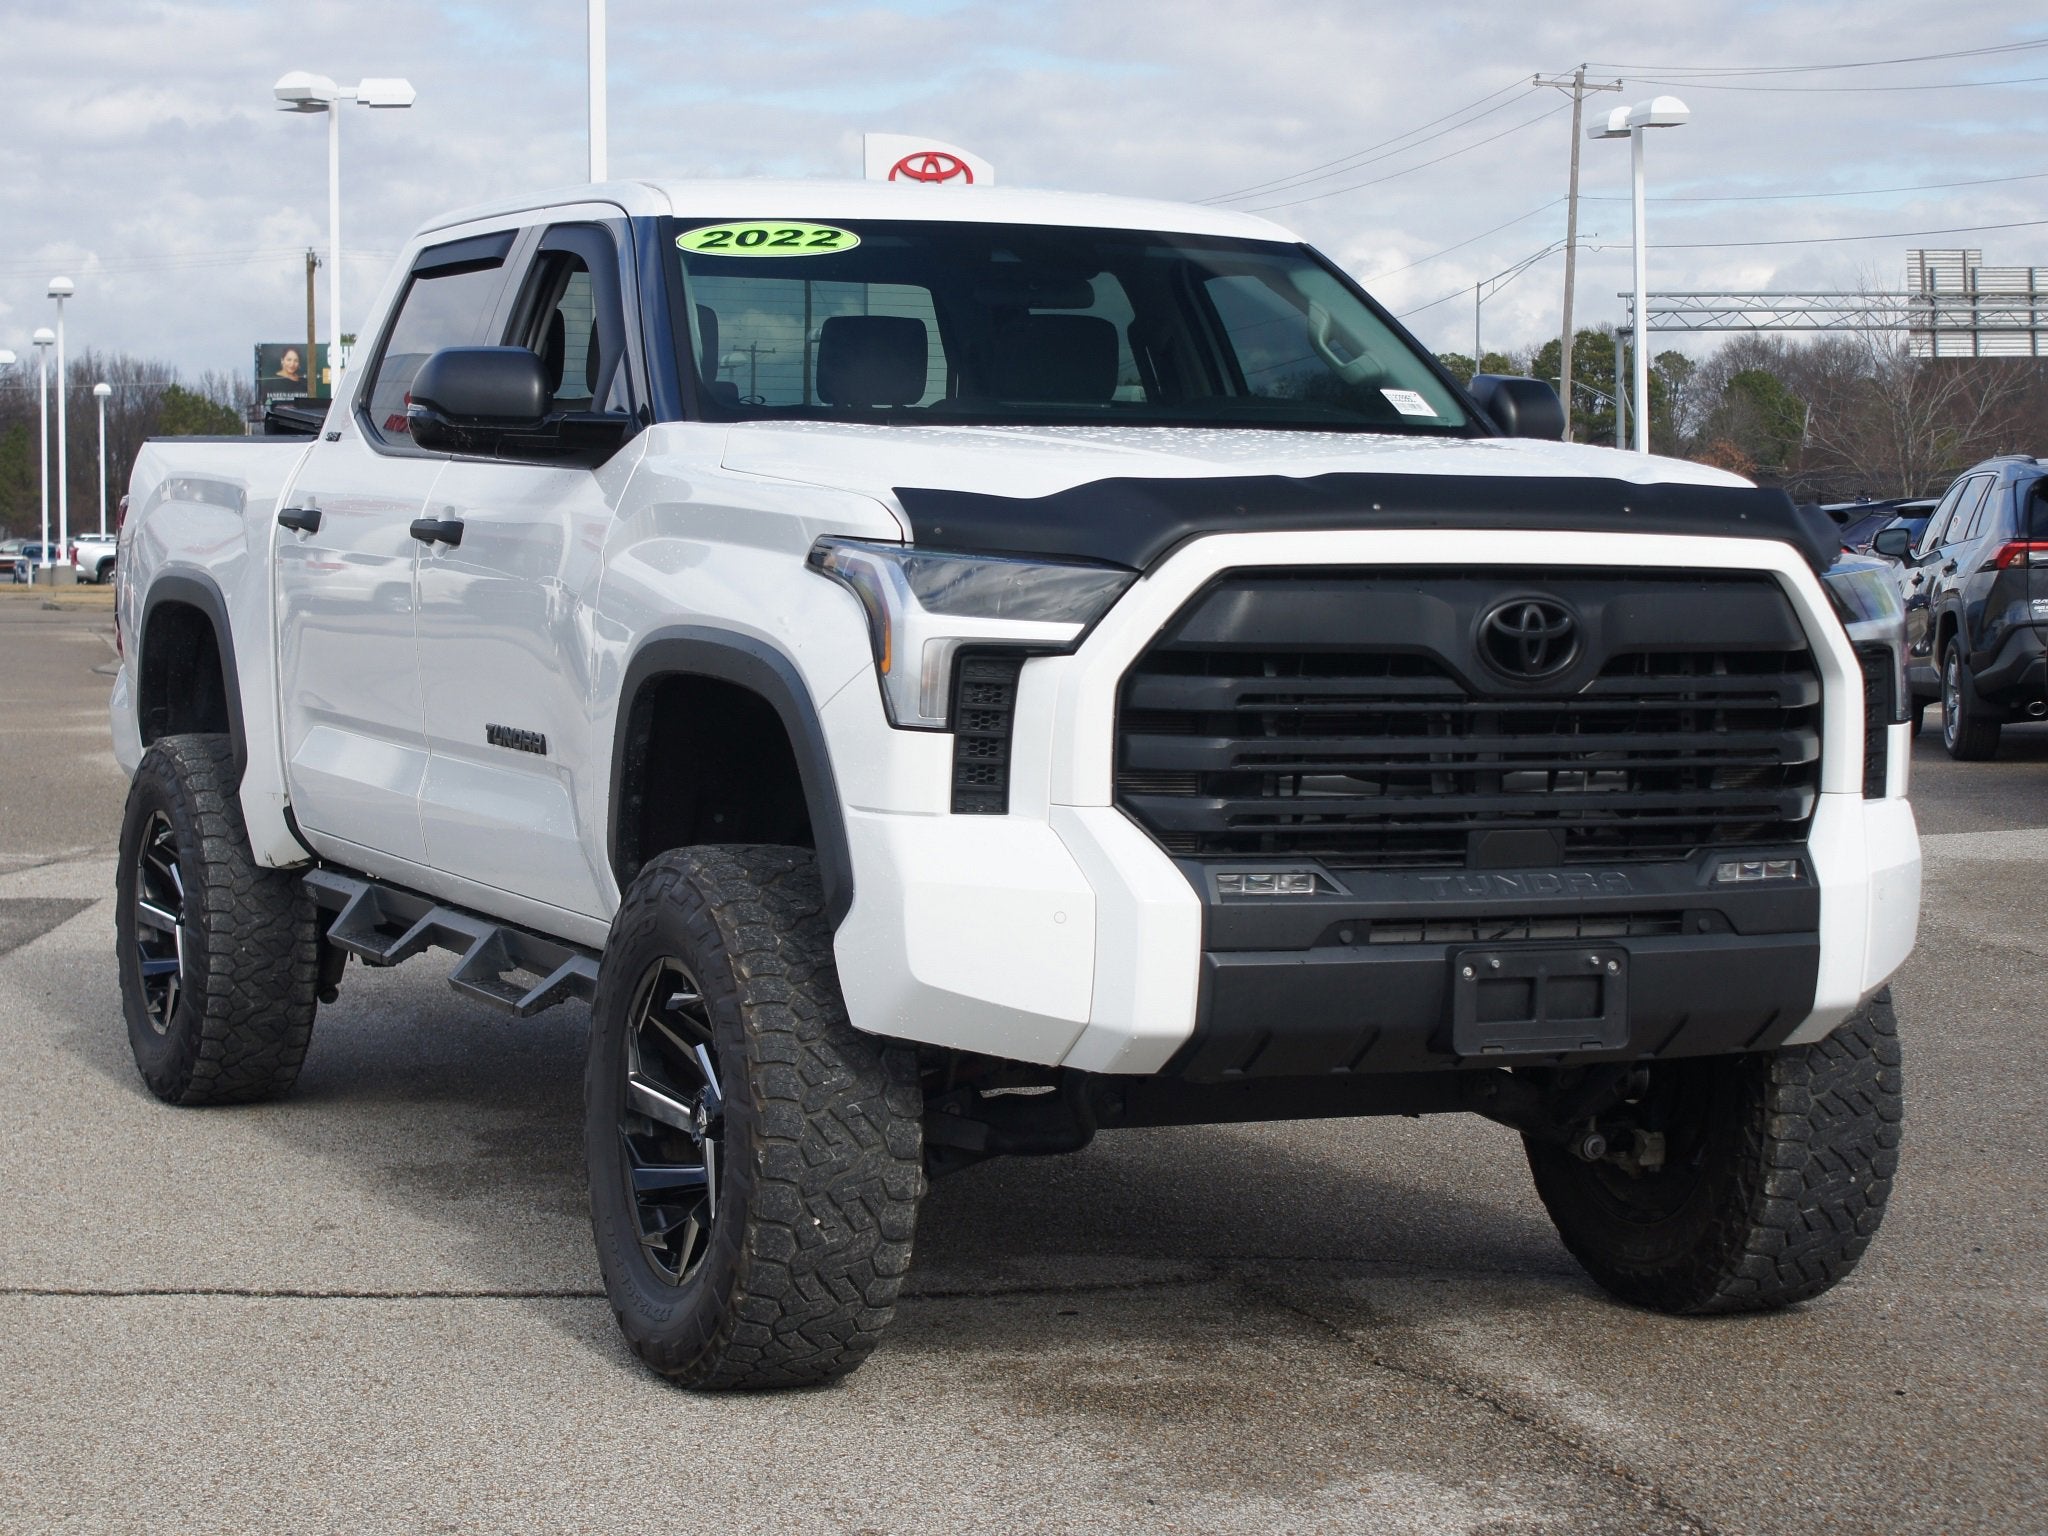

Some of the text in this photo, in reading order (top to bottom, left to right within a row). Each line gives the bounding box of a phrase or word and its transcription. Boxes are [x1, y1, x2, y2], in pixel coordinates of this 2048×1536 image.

[697, 229, 842, 249] 2022
[485, 722, 547, 756] TUNDRA
[1418, 871, 1634, 897] TUNDRA
